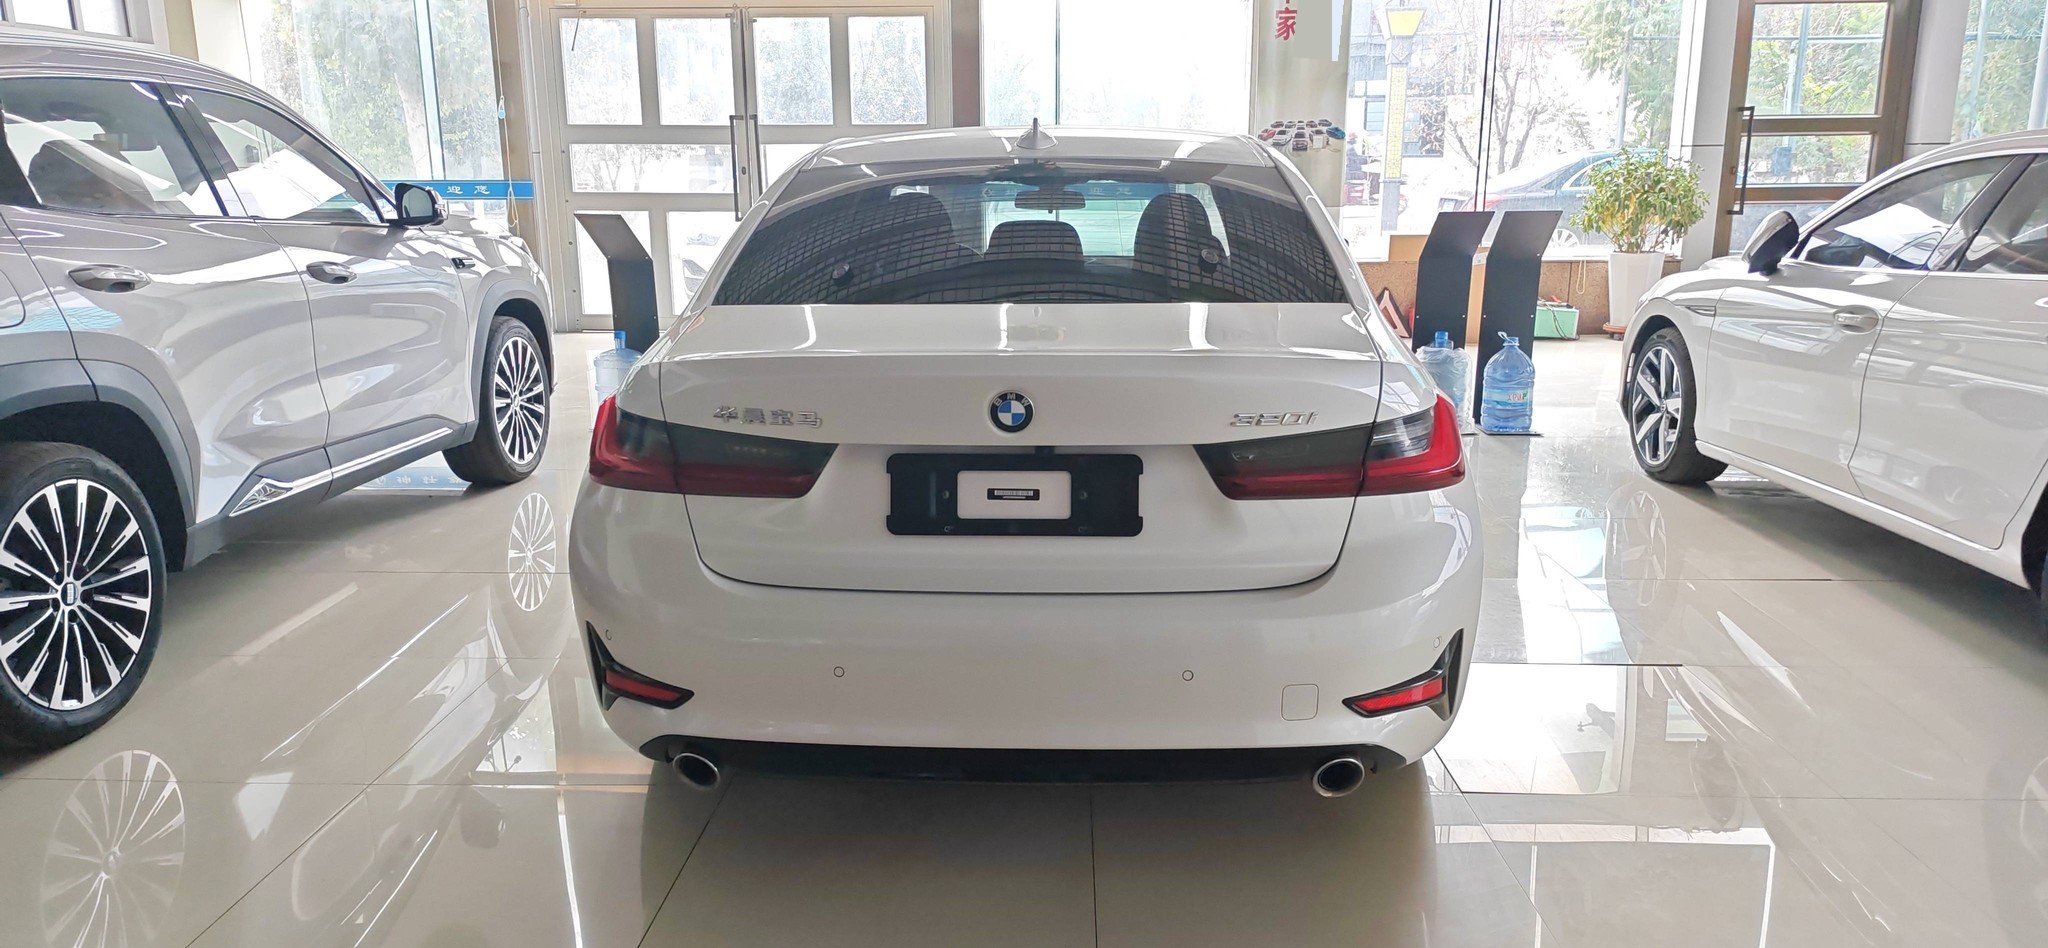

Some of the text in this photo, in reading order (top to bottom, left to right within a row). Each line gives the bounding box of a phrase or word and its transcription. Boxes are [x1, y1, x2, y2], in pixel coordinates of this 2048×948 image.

[1275, 0, 1298, 41] 家
[426, 185, 490, 195] 迎您
[1230, 411, 1319, 427] 320i
